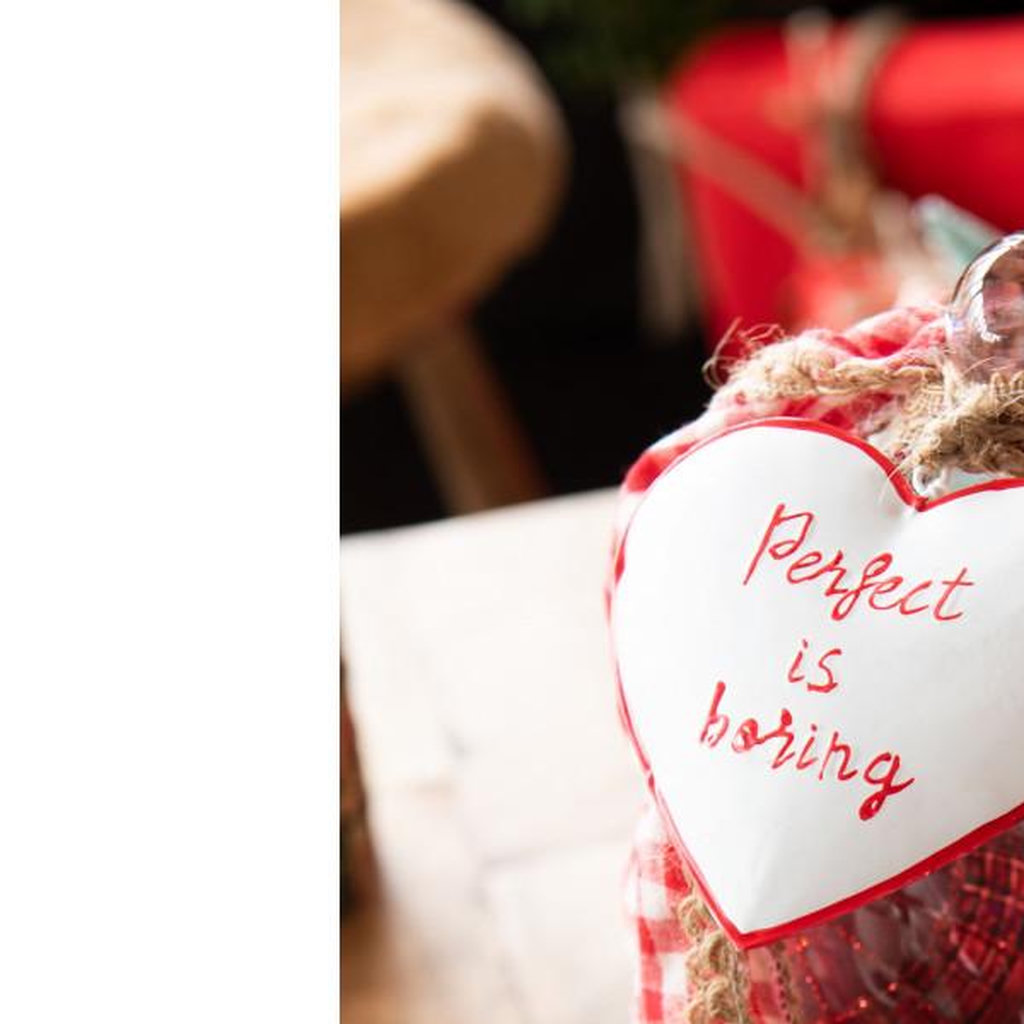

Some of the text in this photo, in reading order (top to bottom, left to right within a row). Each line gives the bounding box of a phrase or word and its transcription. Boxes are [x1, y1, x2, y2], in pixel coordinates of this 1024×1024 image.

[743, 503, 974, 622] Perfect
[788, 639, 842, 694] is
[700, 681, 916, 821] boring
